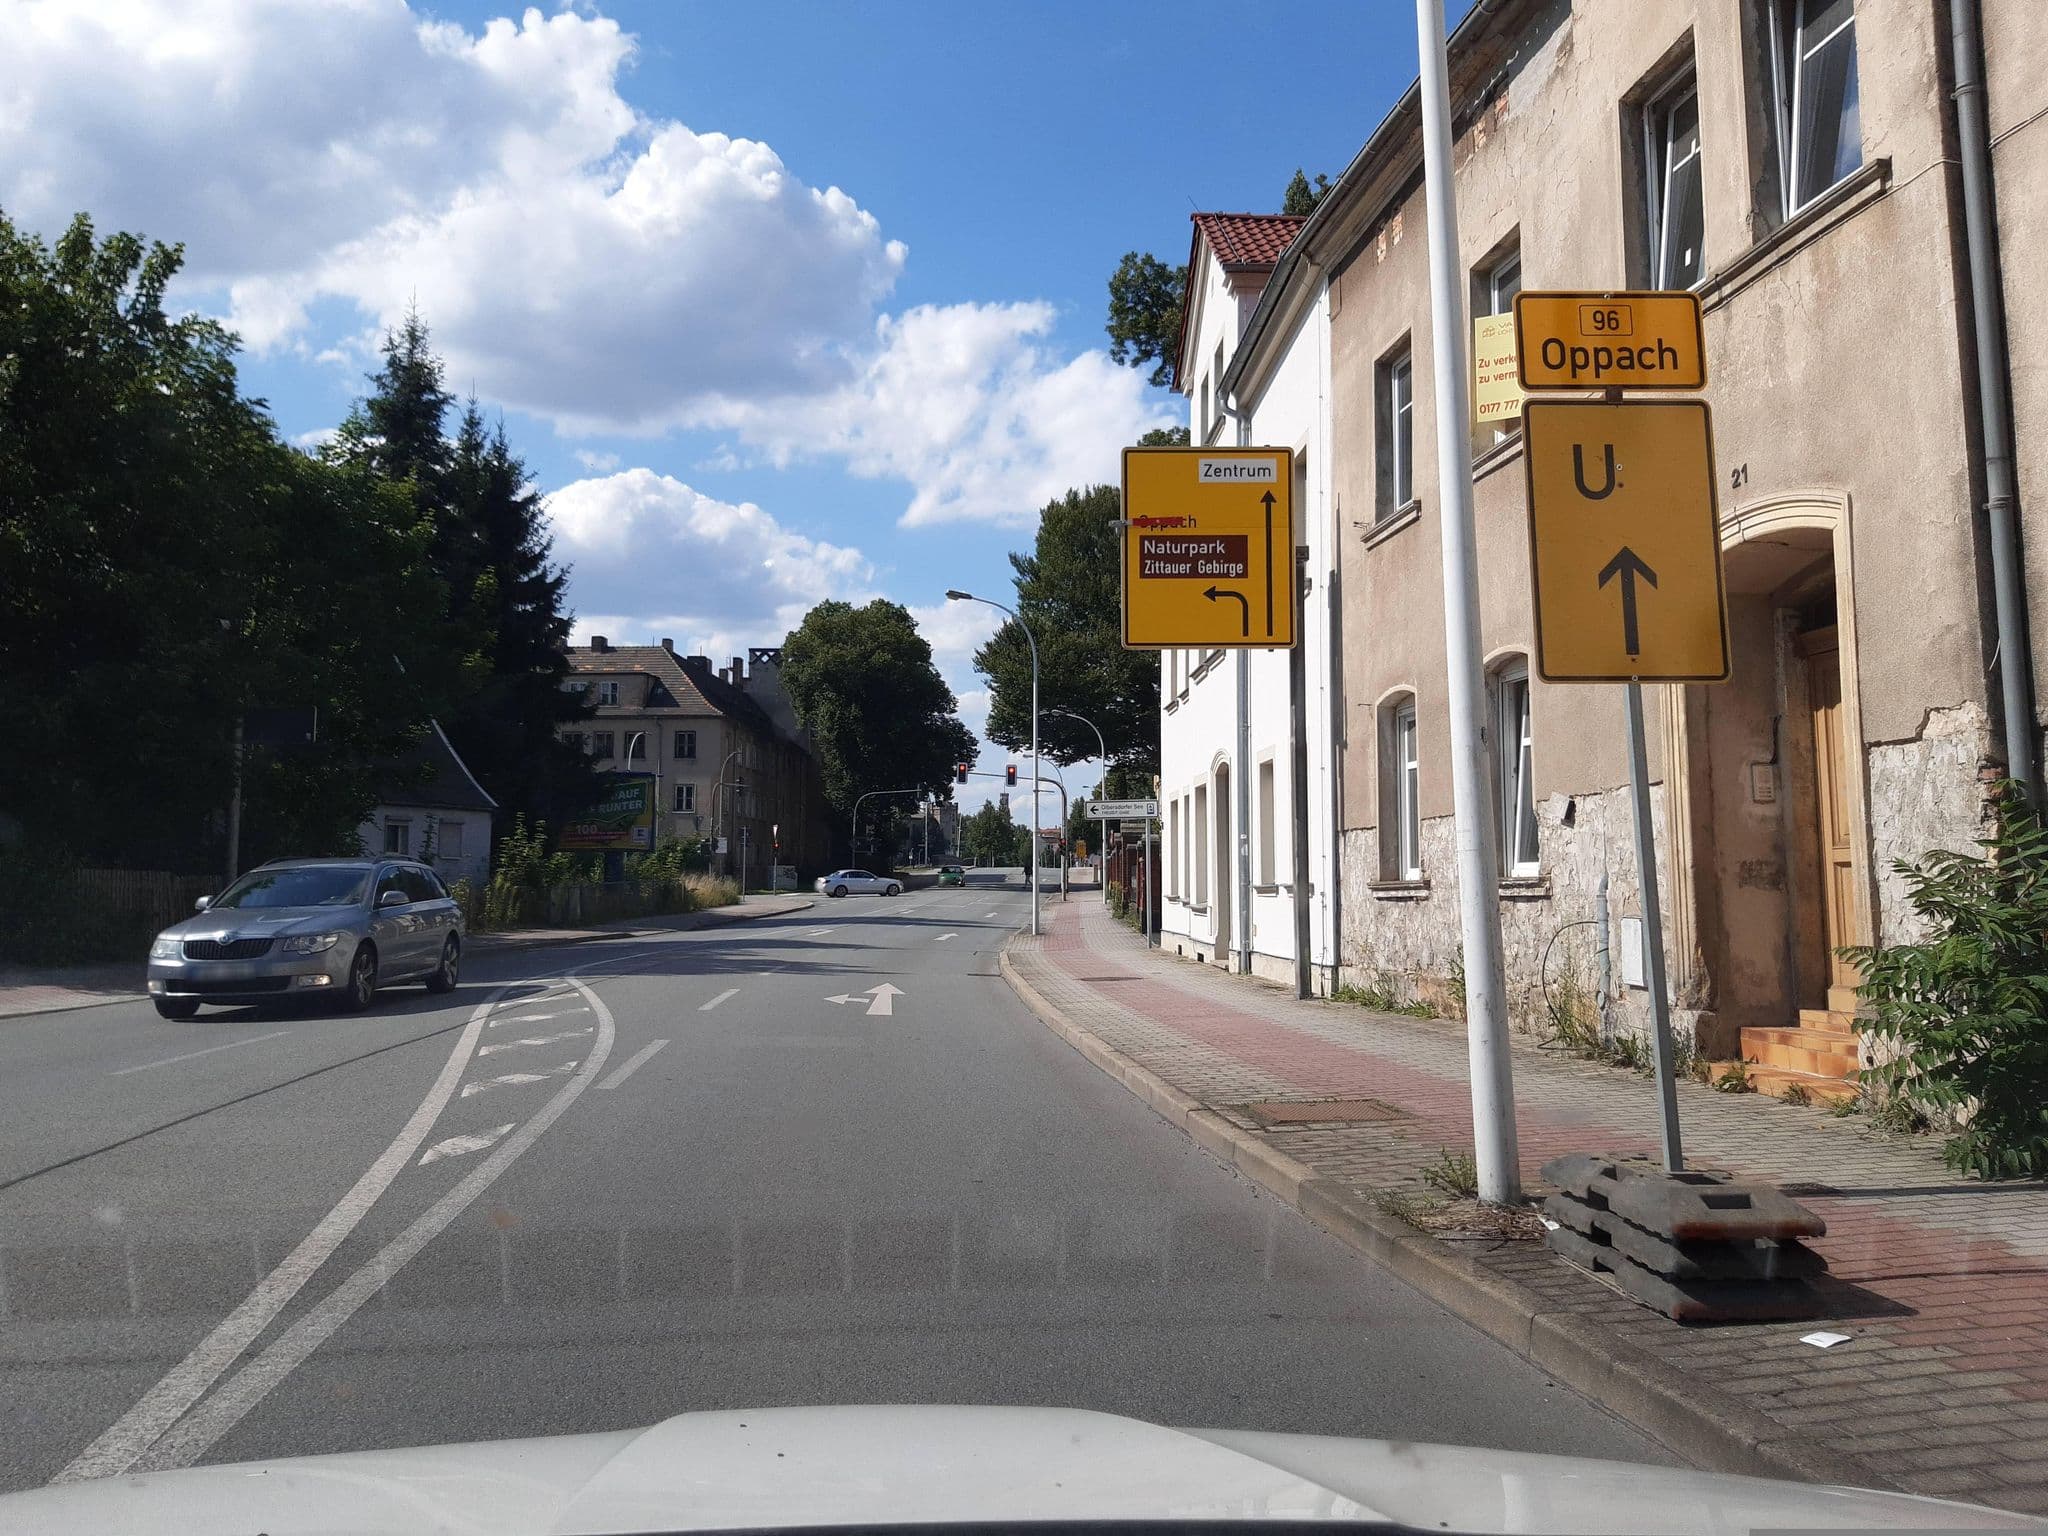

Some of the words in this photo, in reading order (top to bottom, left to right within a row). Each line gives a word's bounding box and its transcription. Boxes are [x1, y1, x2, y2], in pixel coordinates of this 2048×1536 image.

[1592, 309, 1620, 331] 96
[1479, 359, 1490, 369] Zu
[1541, 337, 1679, 379] Oppach
[1479, 375, 1490, 384] zu
[1480, 402, 1500, 414] 0177
[1203, 463, 1272, 478] Zentrum
[1731, 462, 1748, 489] 21
[1144, 540, 1225, 558] Naturpark
[1144, 560, 1191, 575] Zittauer
[1197, 560, 1244, 578] Gebirge
